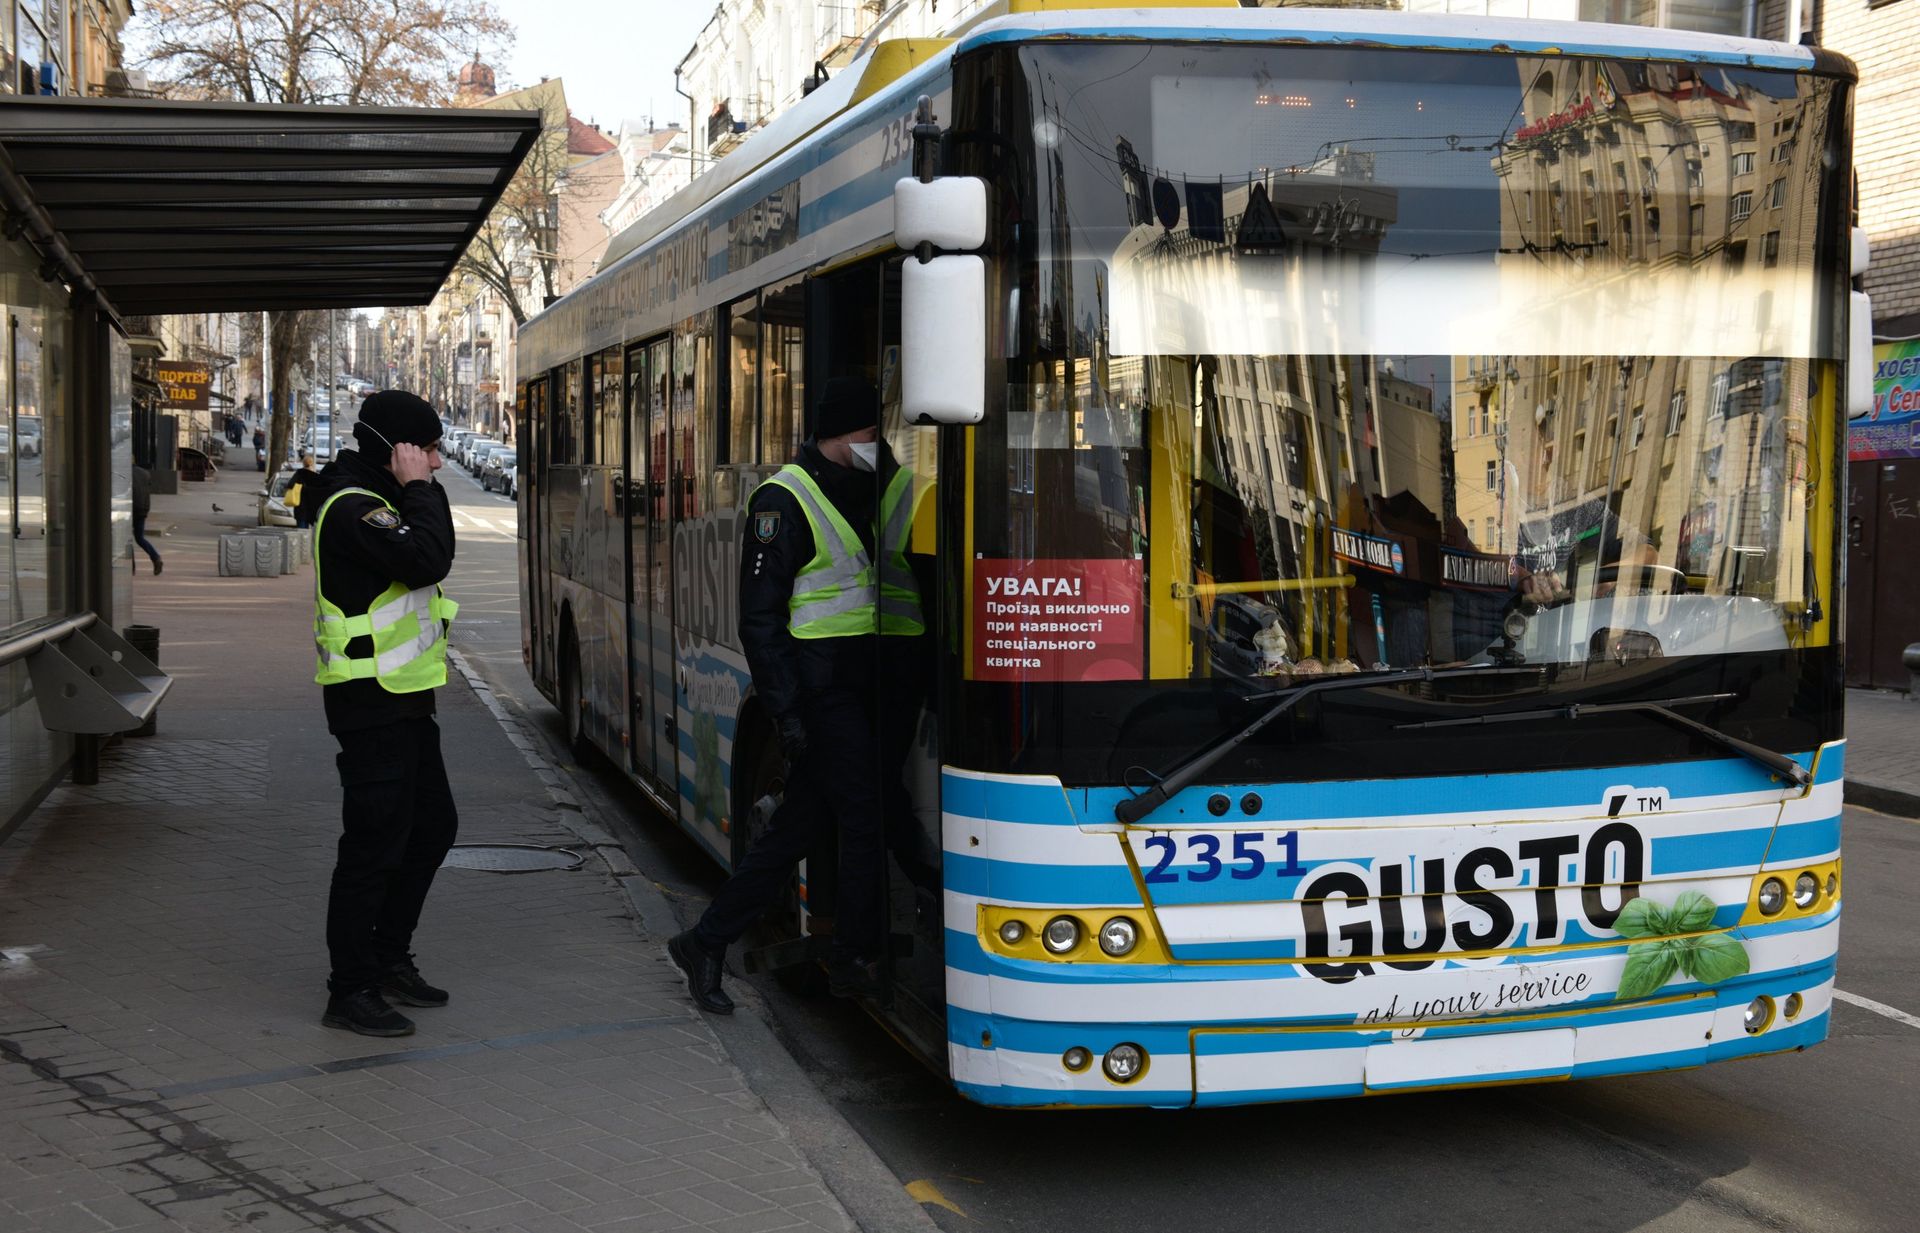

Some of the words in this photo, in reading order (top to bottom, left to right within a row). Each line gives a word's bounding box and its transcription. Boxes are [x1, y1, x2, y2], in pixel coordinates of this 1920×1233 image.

[881, 111, 913, 172] 235
[656, 225, 709, 306] ГІРЧИЦЯ
[159, 370, 208, 384] ПОРТЕР
[170, 387, 197, 400] ПАБ
[986, 577, 1081, 596] УВАГА!
[986, 601, 1041, 615] Проїзд
[1045, 604, 1130, 615] виключно
[986, 620, 1015, 633] при
[1020, 619, 1102, 632] наявності
[986, 637, 1096, 650] спеціального
[986, 656, 1041, 668] квитка
[1145, 831, 1307, 884] 2351
[1301, 794, 1644, 985] GUSTÓ
[1637, 796, 1662, 812] TM
[1363, 994, 1404, 1025] at
[1401, 990, 1489, 1037] your
[1494, 971, 1593, 1008] service
